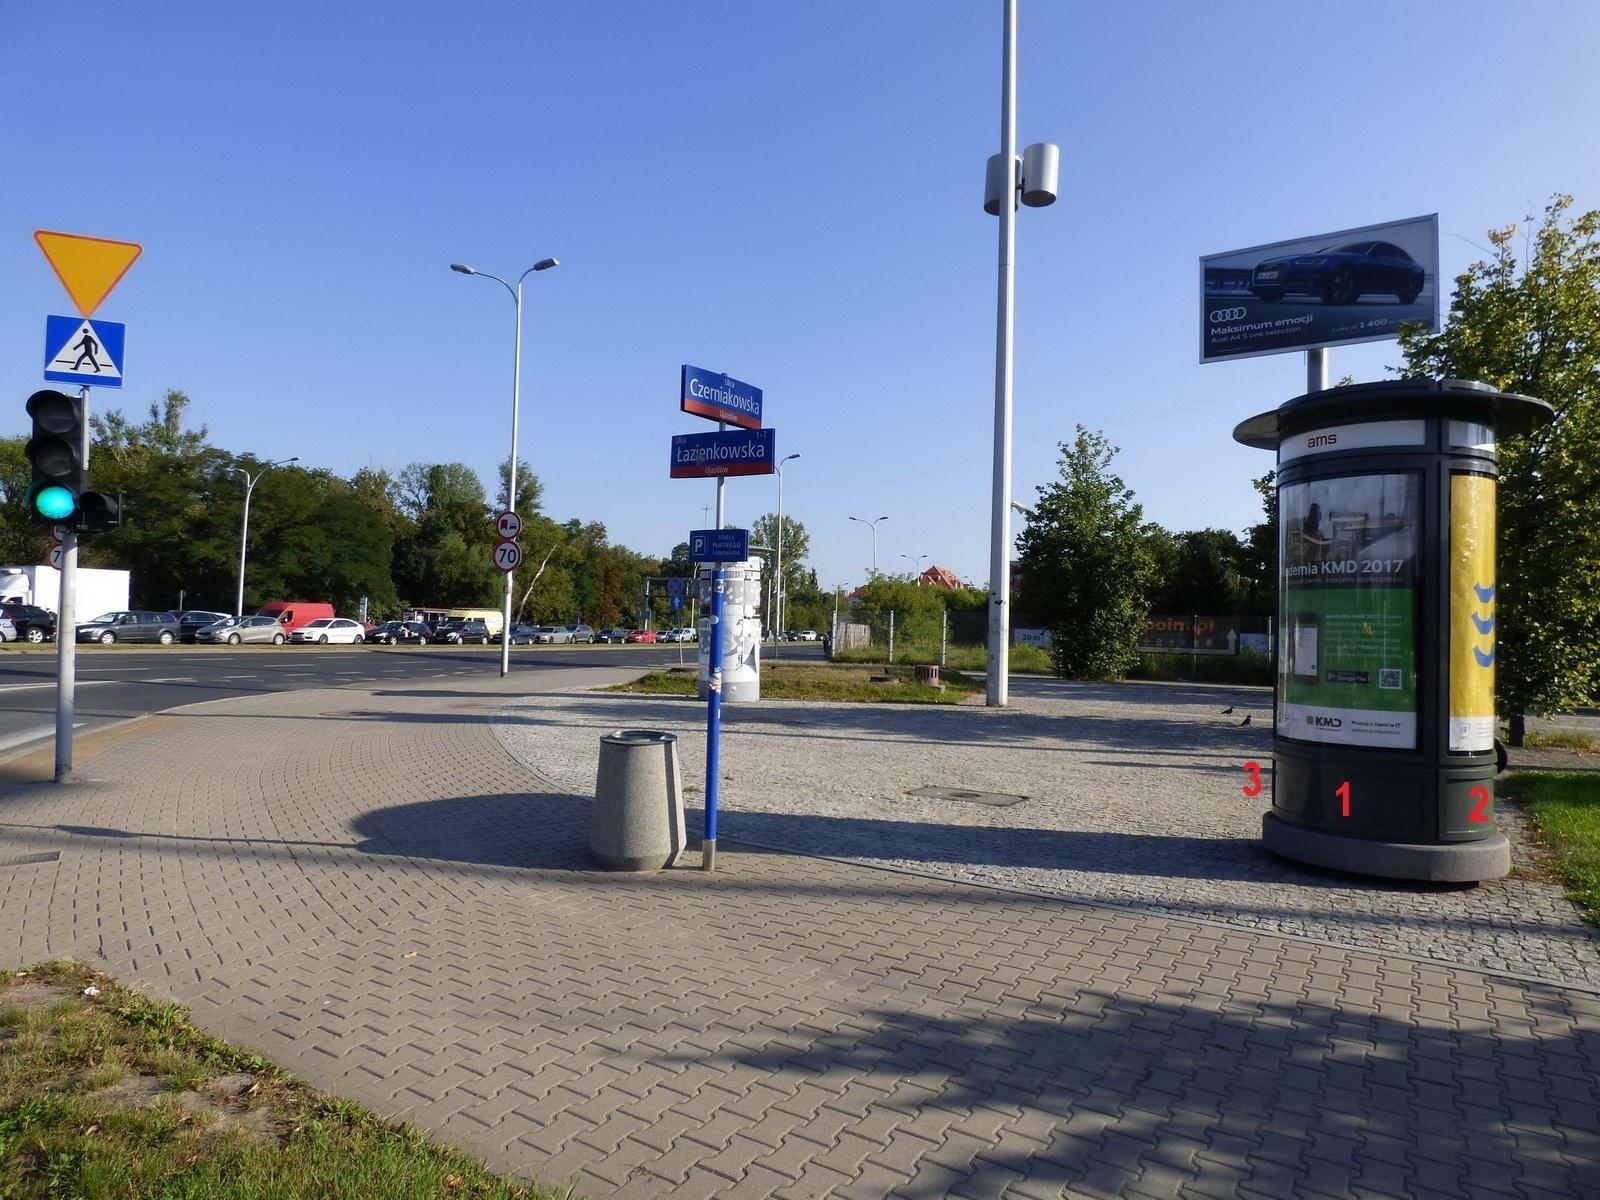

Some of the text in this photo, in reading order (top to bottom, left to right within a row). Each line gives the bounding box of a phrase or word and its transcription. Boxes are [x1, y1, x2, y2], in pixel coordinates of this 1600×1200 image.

[1210, 313, 1313, 336] Maksimum emocji
[1211, 335, 1229, 344] Audi
[1265, 325, 1302, 336] selection
[689, 377, 760, 415] Czerniakowska
[1307, 433, 1337, 448] ams
[677, 440, 765, 462] Łazienkowska
[695, 539, 703, 553] P
[499, 548, 516, 563] 70
[1321, 560, 1357, 574] KMD
[1360, 559, 1404, 574] 2017
[1315, 716, 1342, 728] KMD
